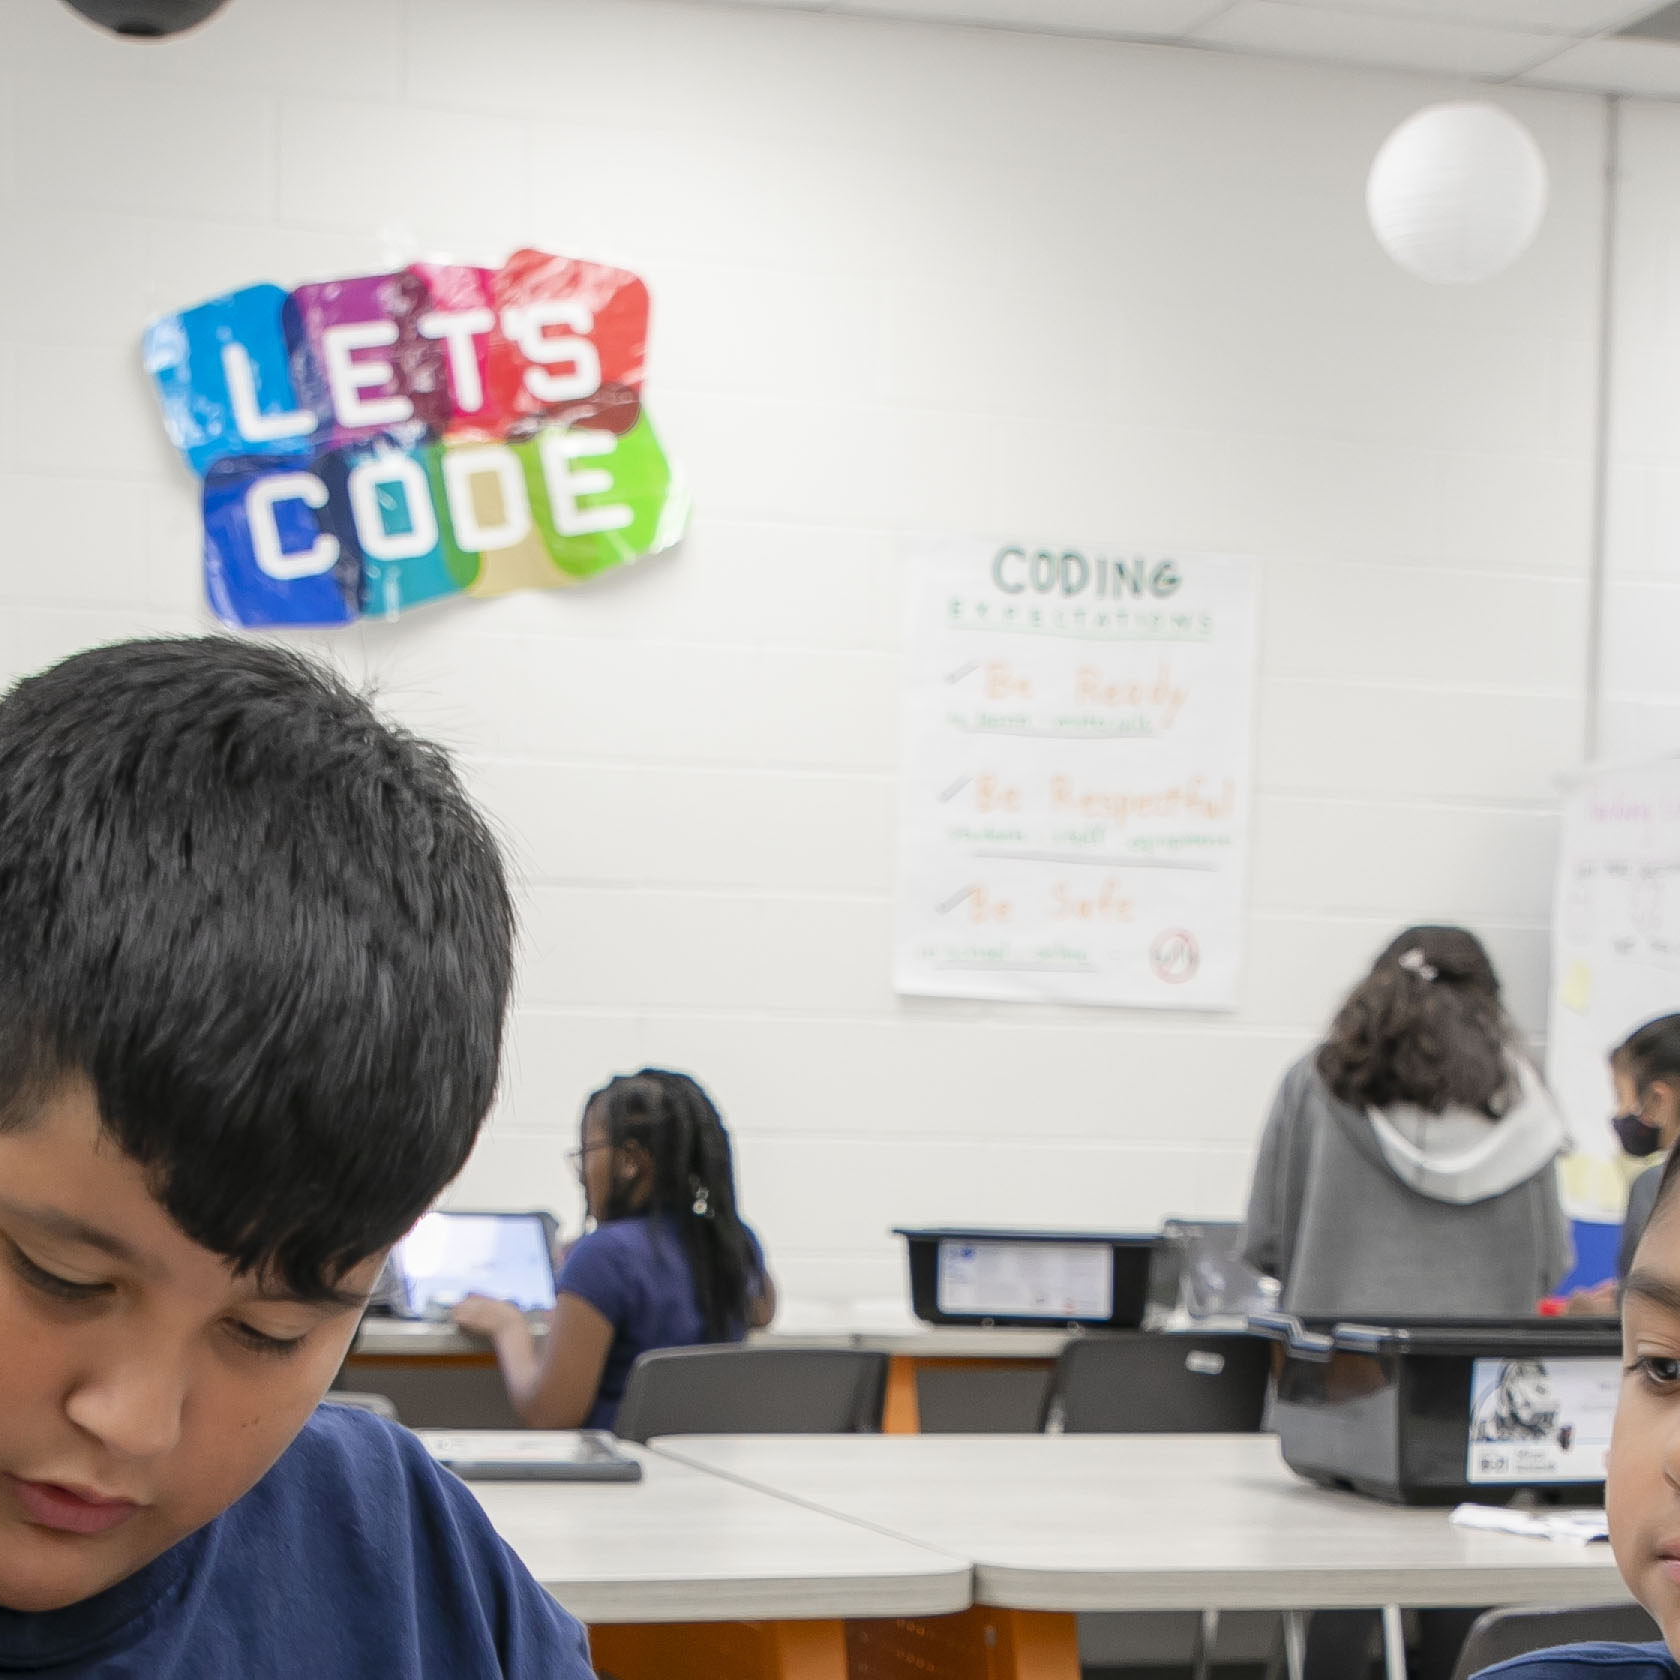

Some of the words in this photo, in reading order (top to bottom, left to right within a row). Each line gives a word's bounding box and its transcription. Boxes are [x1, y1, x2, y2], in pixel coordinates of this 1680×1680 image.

[245, 426, 635, 580] CODE
[991, 543, 1183, 600] CODING
[983, 658, 1035, 701] Be
[1074, 660, 1190, 730] Ready
[972, 770, 1022, 814] Be
[1050, 874, 1136, 924] Safe
